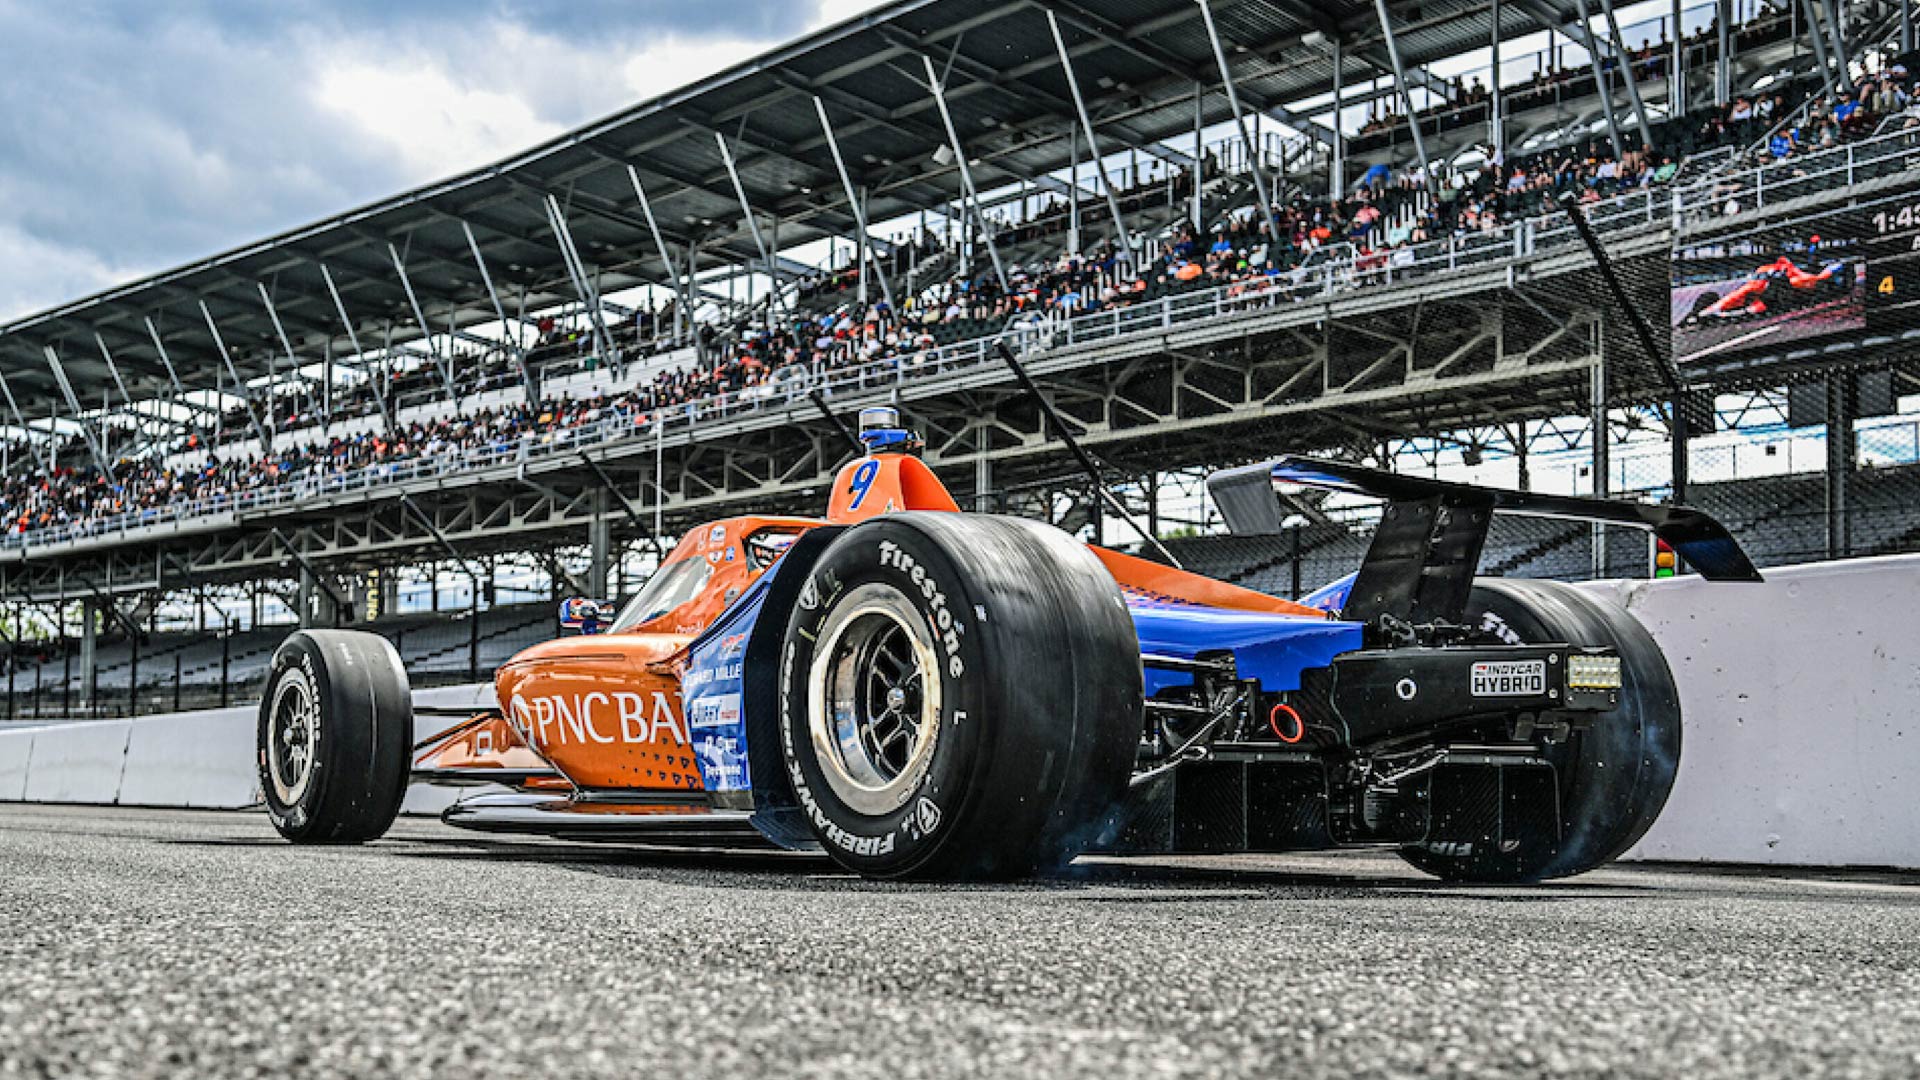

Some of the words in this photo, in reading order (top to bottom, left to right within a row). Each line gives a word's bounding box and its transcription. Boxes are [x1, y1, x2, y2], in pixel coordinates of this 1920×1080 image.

[1878, 275, 1895, 295] 4
[848, 459, 881, 512] 9
[879, 540, 964, 679] Firestone
[1474, 675, 1542, 693] HYBRID
[1488, 663, 1542, 675] INDYCAR
[788, 759, 896, 856] FIREHAWK
